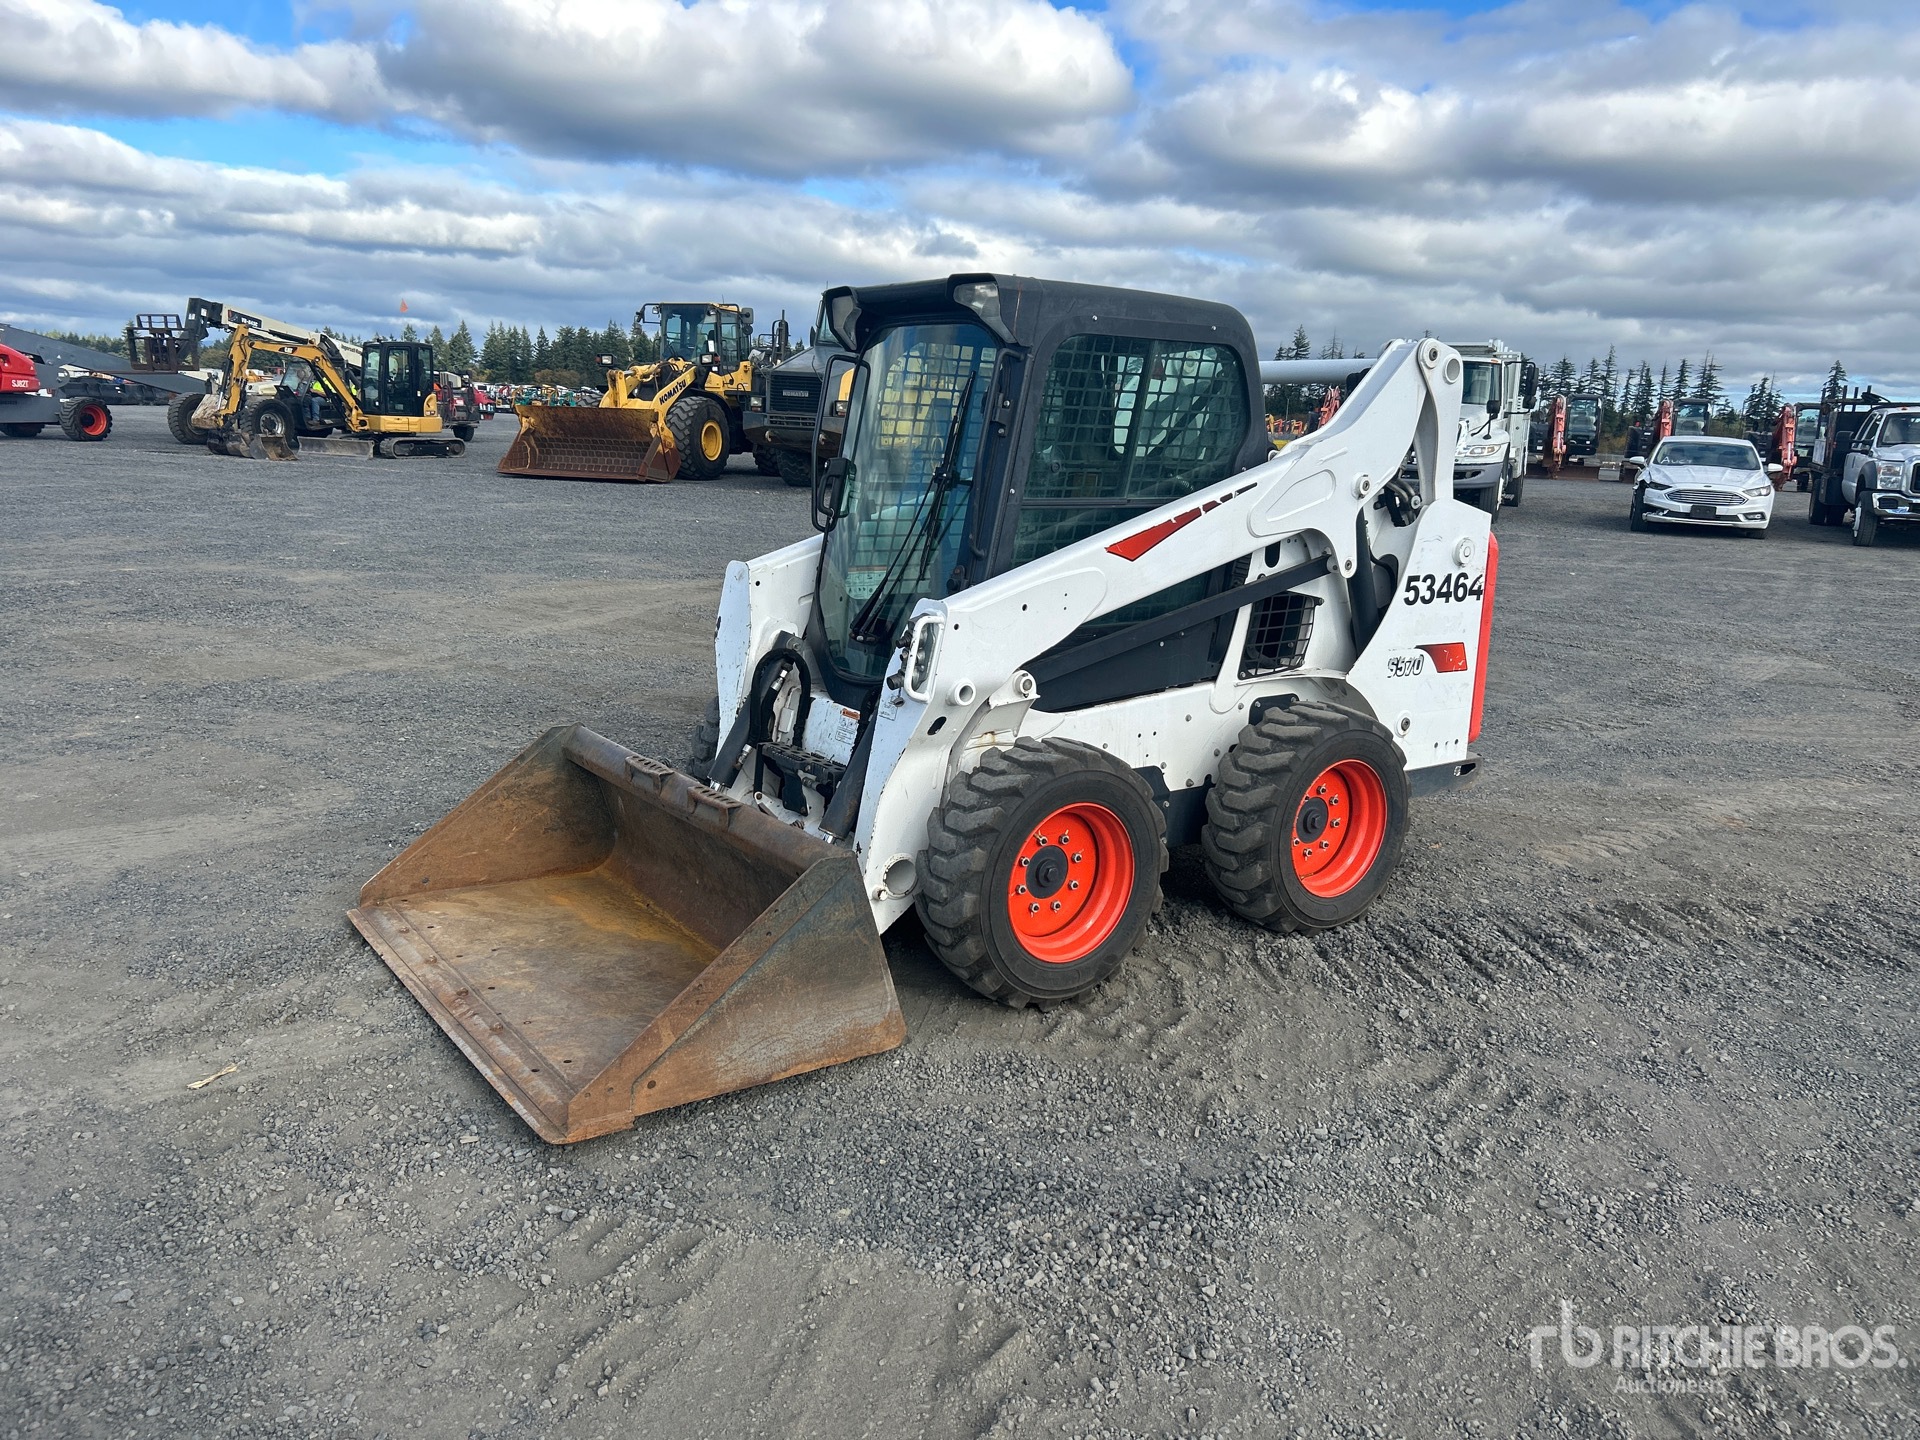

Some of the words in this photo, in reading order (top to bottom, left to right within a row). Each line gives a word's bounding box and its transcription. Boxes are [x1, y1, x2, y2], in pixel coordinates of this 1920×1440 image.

[659, 379, 687, 405] KOMATSU
[1403, 572, 1484, 606] 53464
[1387, 654, 1425, 678] S570
